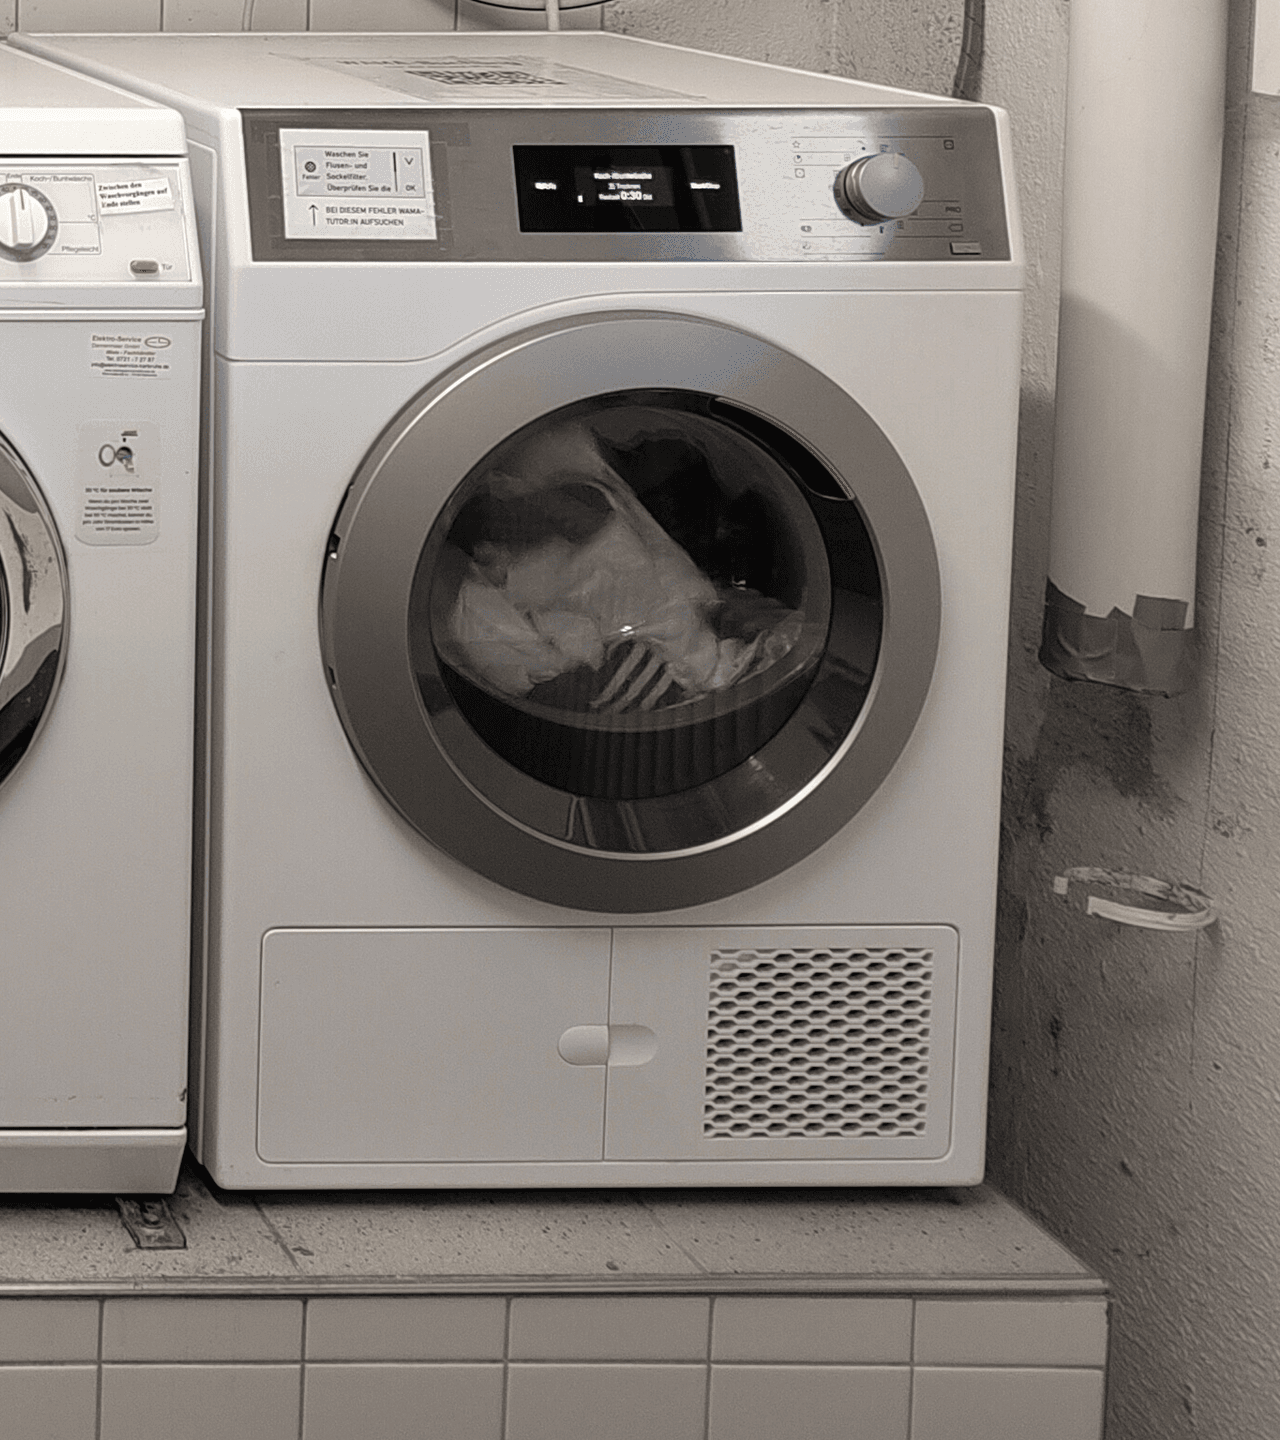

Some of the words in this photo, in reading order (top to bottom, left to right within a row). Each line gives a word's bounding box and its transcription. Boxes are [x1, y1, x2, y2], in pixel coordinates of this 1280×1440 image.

[98, 182, 129, 192] Zwischen
[327, 183, 366, 193] Überprüfen
[99, 189, 156, 200] Waschvorgängen
[157, 187, 168, 195] auf
[620, 191, 642, 201] 0:30
[360, 218, 404, 226] AUFSUCHEN
